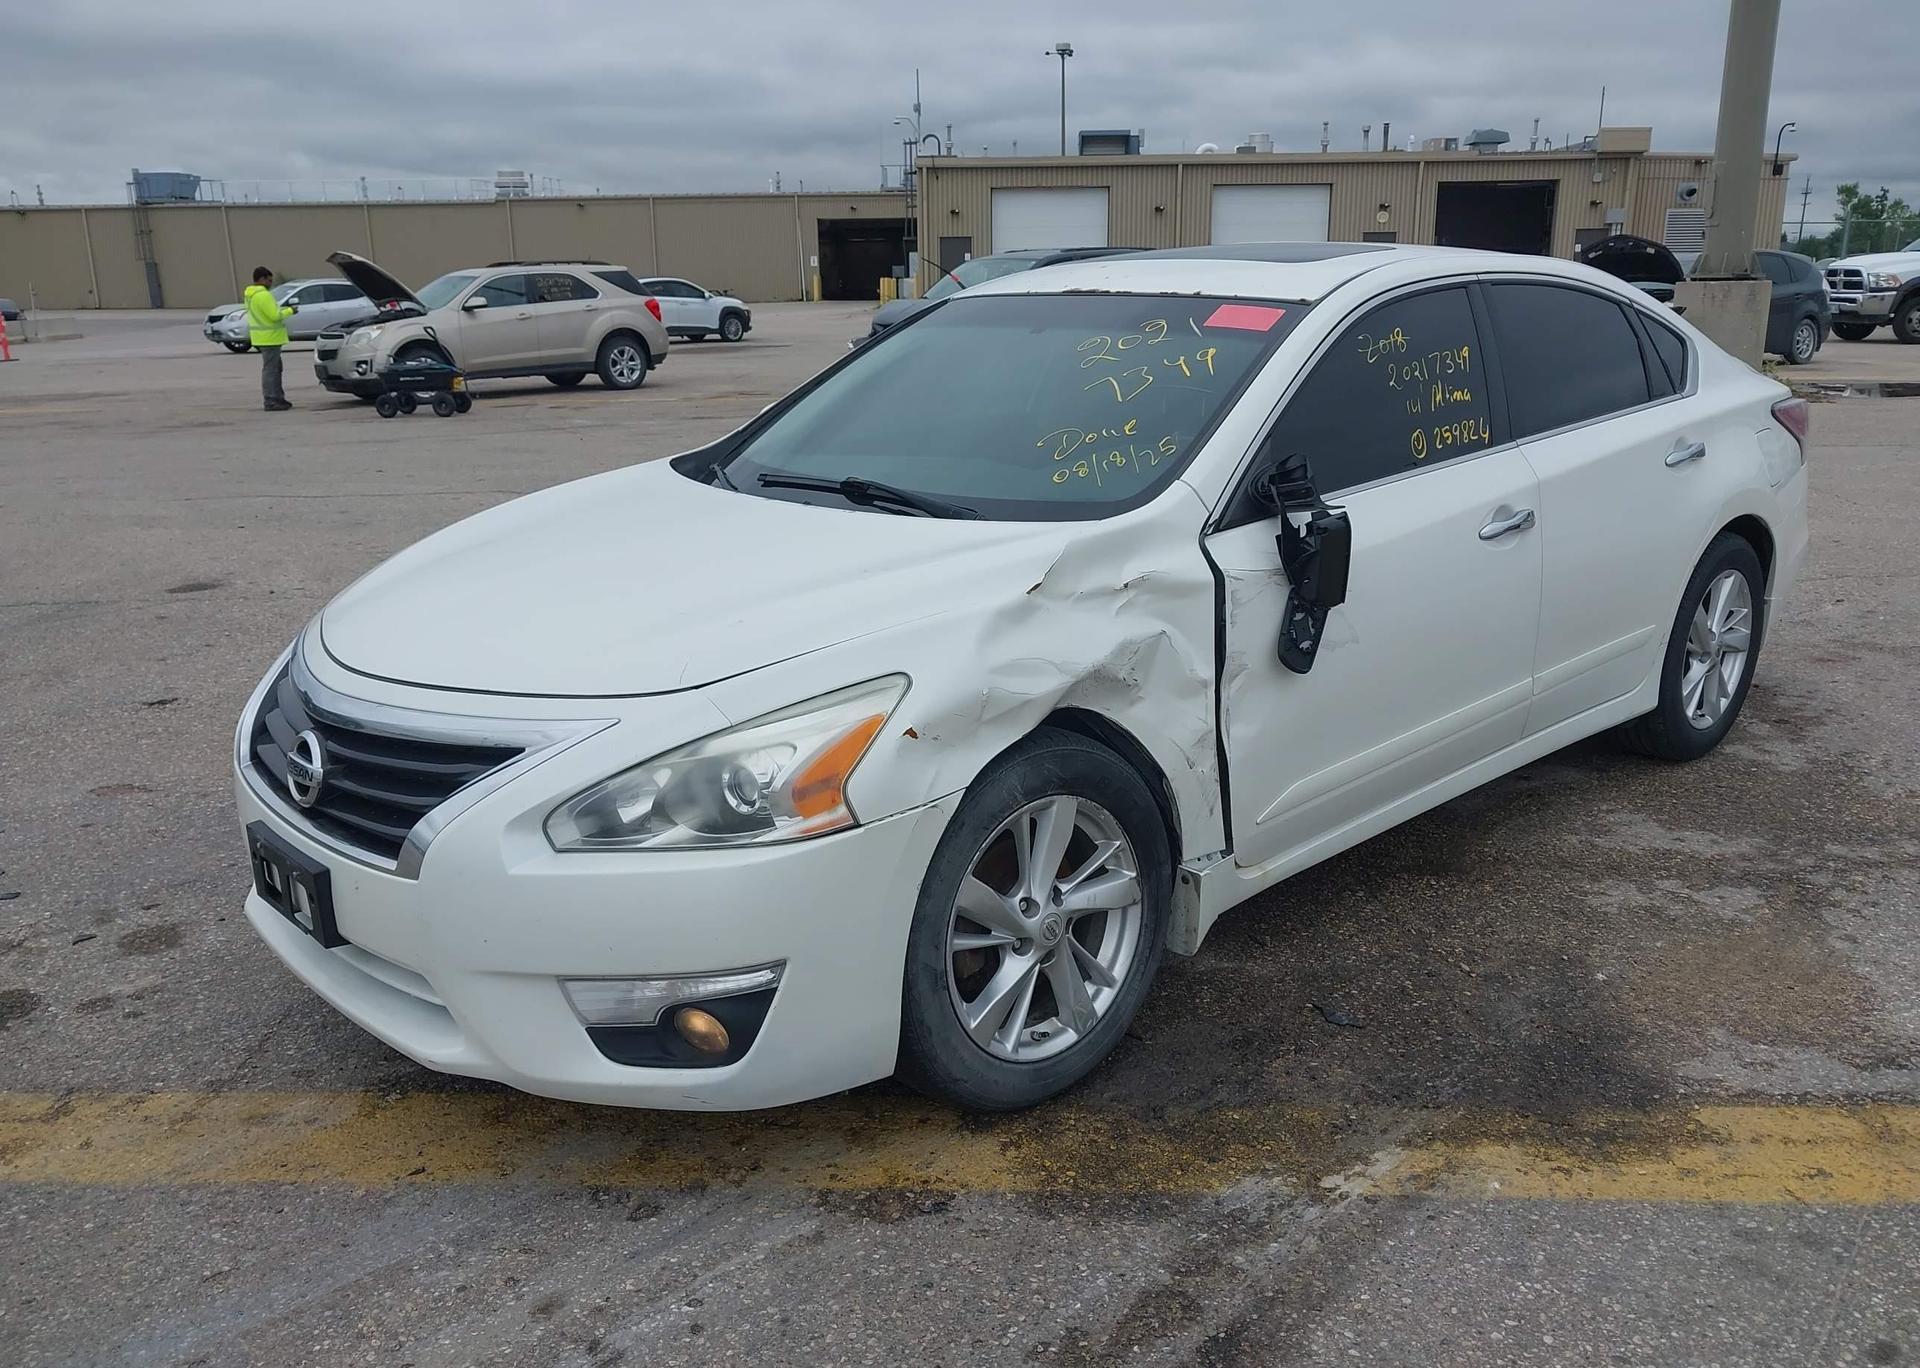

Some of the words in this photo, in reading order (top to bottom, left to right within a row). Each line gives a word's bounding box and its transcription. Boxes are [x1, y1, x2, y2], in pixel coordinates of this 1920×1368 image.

[1083, 347, 1217, 402] 7349
[1434, 417, 1489, 449] 259824
[1052, 436, 1177, 488] 08/18/25
